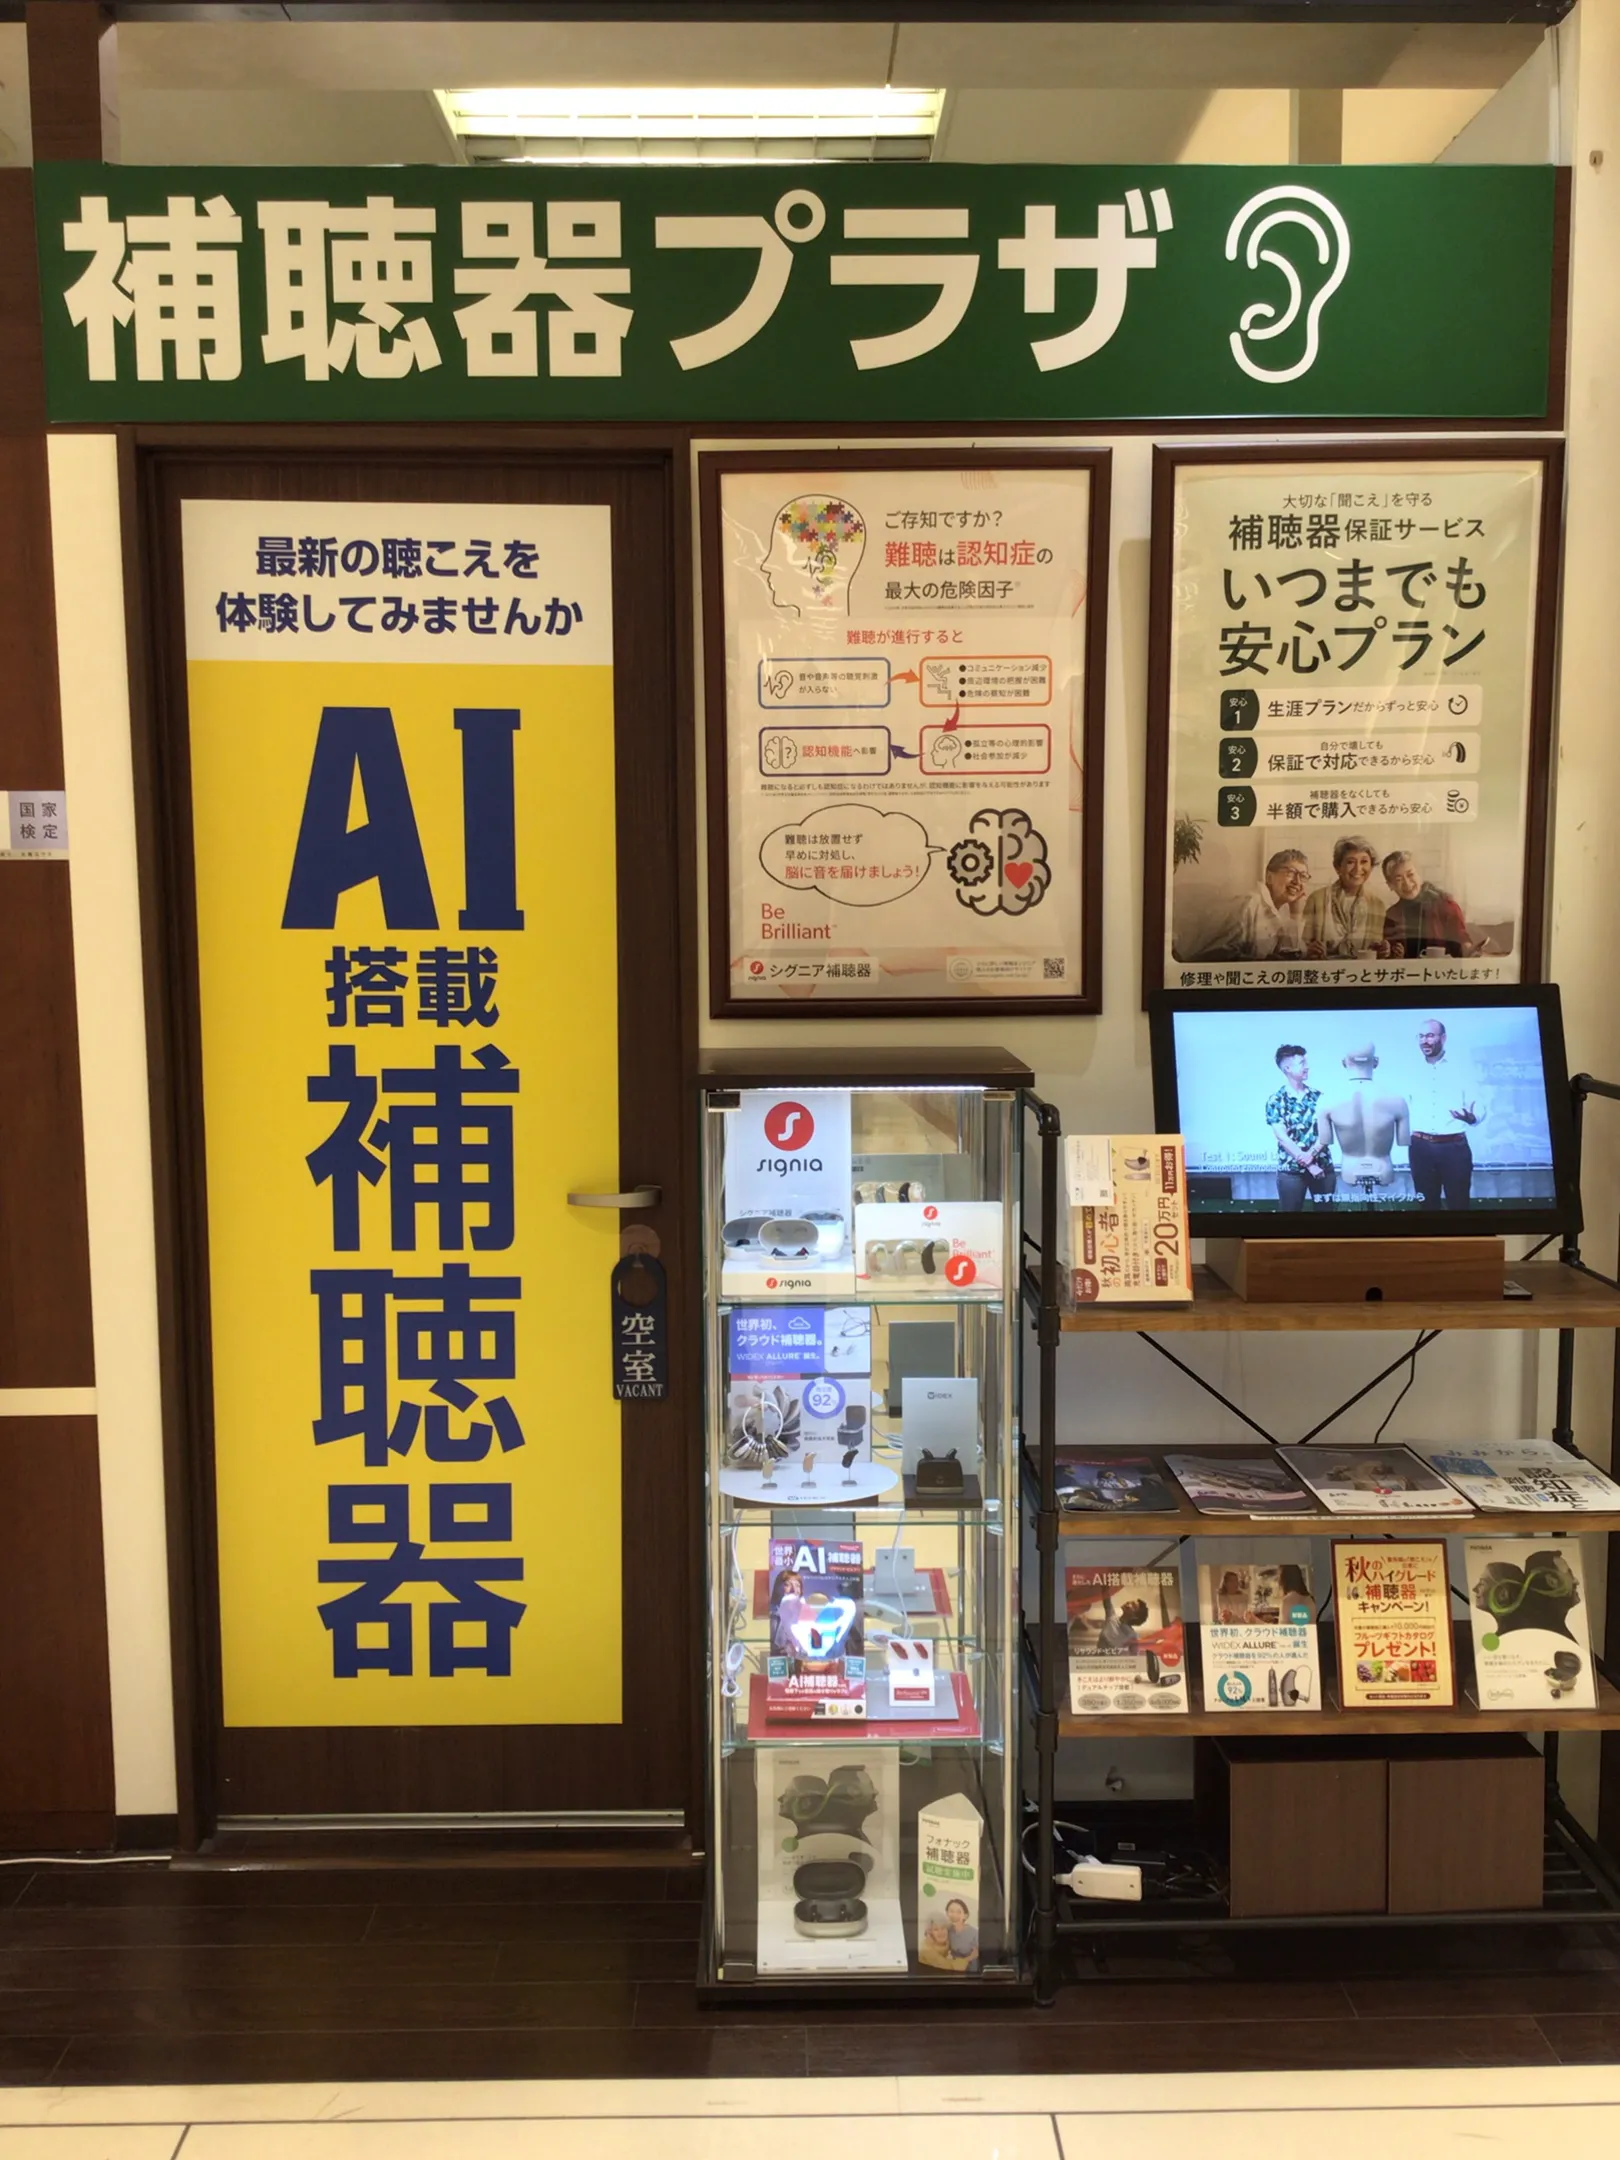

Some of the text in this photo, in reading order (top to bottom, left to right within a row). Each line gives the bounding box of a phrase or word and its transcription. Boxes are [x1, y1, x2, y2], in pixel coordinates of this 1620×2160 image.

[62, 189, 1174, 381] 補聴器プラザ
[1282, 492, 1434, 508] 大切な「聞こえ」を守る
[884, 510, 1004, 529] ご存知ですか?
[1228, 513, 1486, 551] 補聴器保証サービス
[255, 536, 540, 580] 最新の聴こえを
[884, 541, 1054, 568] 難聴は認知症の
[884, 580, 1015, 600] 最大の危険因子
[1222, 556, 1487, 613] いつまでも
[215, 592, 584, 636] 体験してみませんか
[846, 629, 964, 646] 難聴が進行すると
[1218, 616, 1487, 677] 安心プラン
[1229, 697, 1249, 708] 安心
[1267, 699, 1440, 718] 生涯プランだからずっと安心
[1234, 710, 1242, 724] 1
[1227, 745, 1247, 756] 安心
[1231, 758, 1242, 772] 2
[1267, 753, 1436, 772] 保証で対応できるから安心
[1226, 793, 1246, 804] 安心
[19, 802, 58, 818] 国家
[281, 706, 525, 931] AI
[1230, 806, 1241, 820] 3
[1266, 801, 1433, 820] 半額で購入できるから安心
[19, 823, 58, 840] 検定
[784, 833, 864, 846] 難聴は放置せず
[784, 849, 857, 862] 早めに対処し、
[784, 864, 921, 880] 脳に音を届けましょう!
[760, 902, 786, 920] Be
[760, 922, 832, 940] Brilliant
[769, 962, 873, 979] シグニア補聴器
[1179, 967, 1501, 988] 修理や聞こえの調整もずっとサポートいたします!
[324, 945, 500, 1028] 搭載
[756, 1158, 823, 1177] signia
[1153, 1196, 1179, 1256] 20万円
[952, 1238, 966, 1248] Be
[779, 1279, 812, 1289] signia
[620, 1312, 656, 1383] 空室
[766, 1352, 800, 1360] ALLURE
[305, 1043, 527, 1679] 補聴器
[615, 1383, 664, 1398] VACANT
[791, 1545, 827, 1574] AI
[1344, 1555, 1383, 1583] 秋の
[1371, 1569, 1437, 1583] ハイグレード
[1092, 1571, 1175, 1587] AI搭載補聴器
[1365, 1583, 1417, 1601] 補聴器
[1358, 1601, 1430, 1613] キャンペーン!
[1210, 1627, 1308, 1638] 世界初、クラウド補聴器
[1211, 1641, 1242, 1650] WIDEX
[1242, 1640, 1277, 1649] ALLURE
[1353, 1640, 1437, 1658] プレゼント!
[926, 1846, 971, 1866] 補聴器
